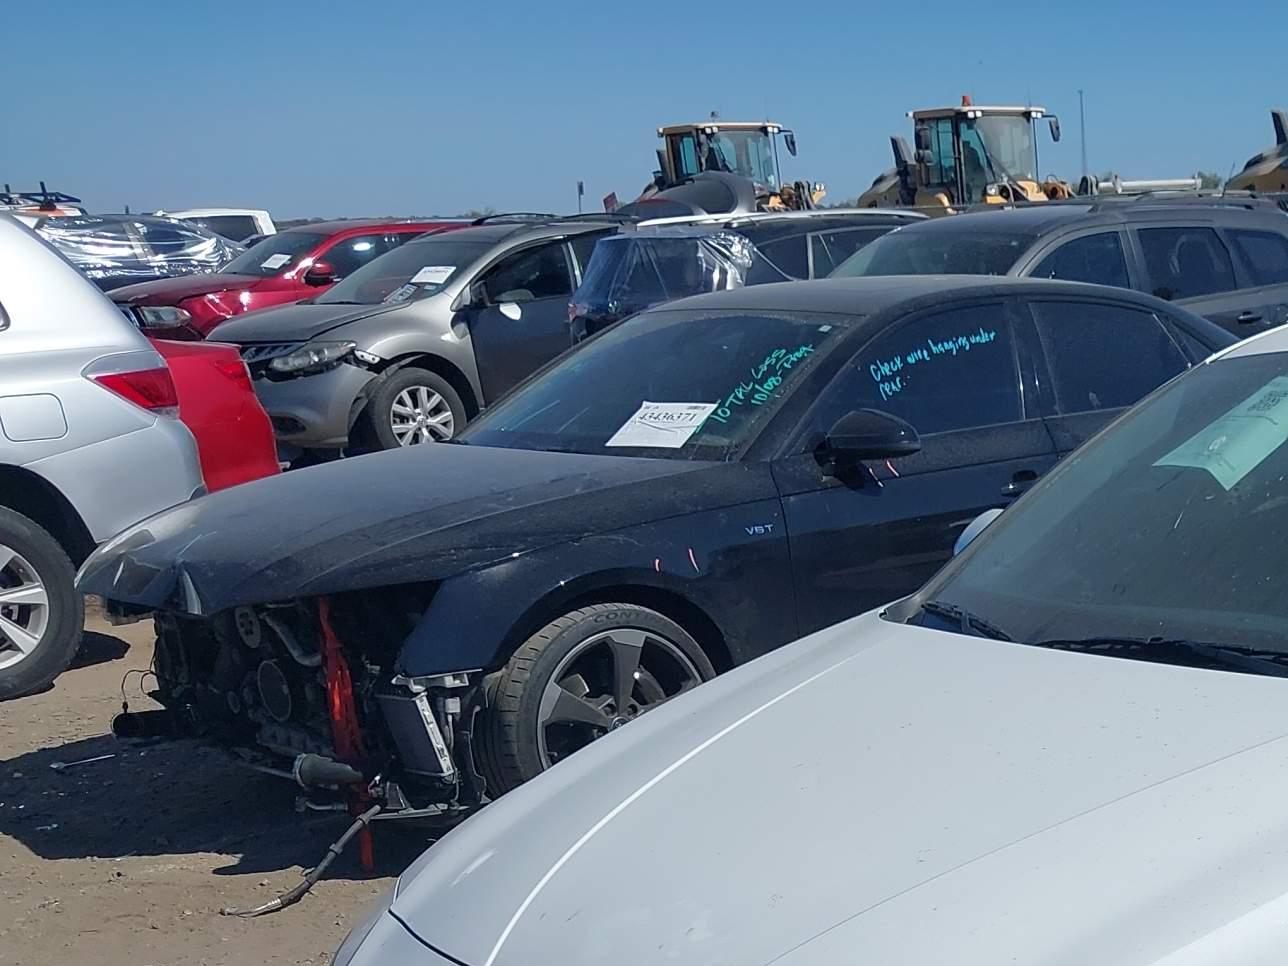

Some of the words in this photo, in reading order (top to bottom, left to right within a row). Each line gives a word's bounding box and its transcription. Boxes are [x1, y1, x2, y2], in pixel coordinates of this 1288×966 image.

[870, 355, 903, 382] Check
[927, 339, 970, 356] hanging
[969, 327, 997, 345] under
